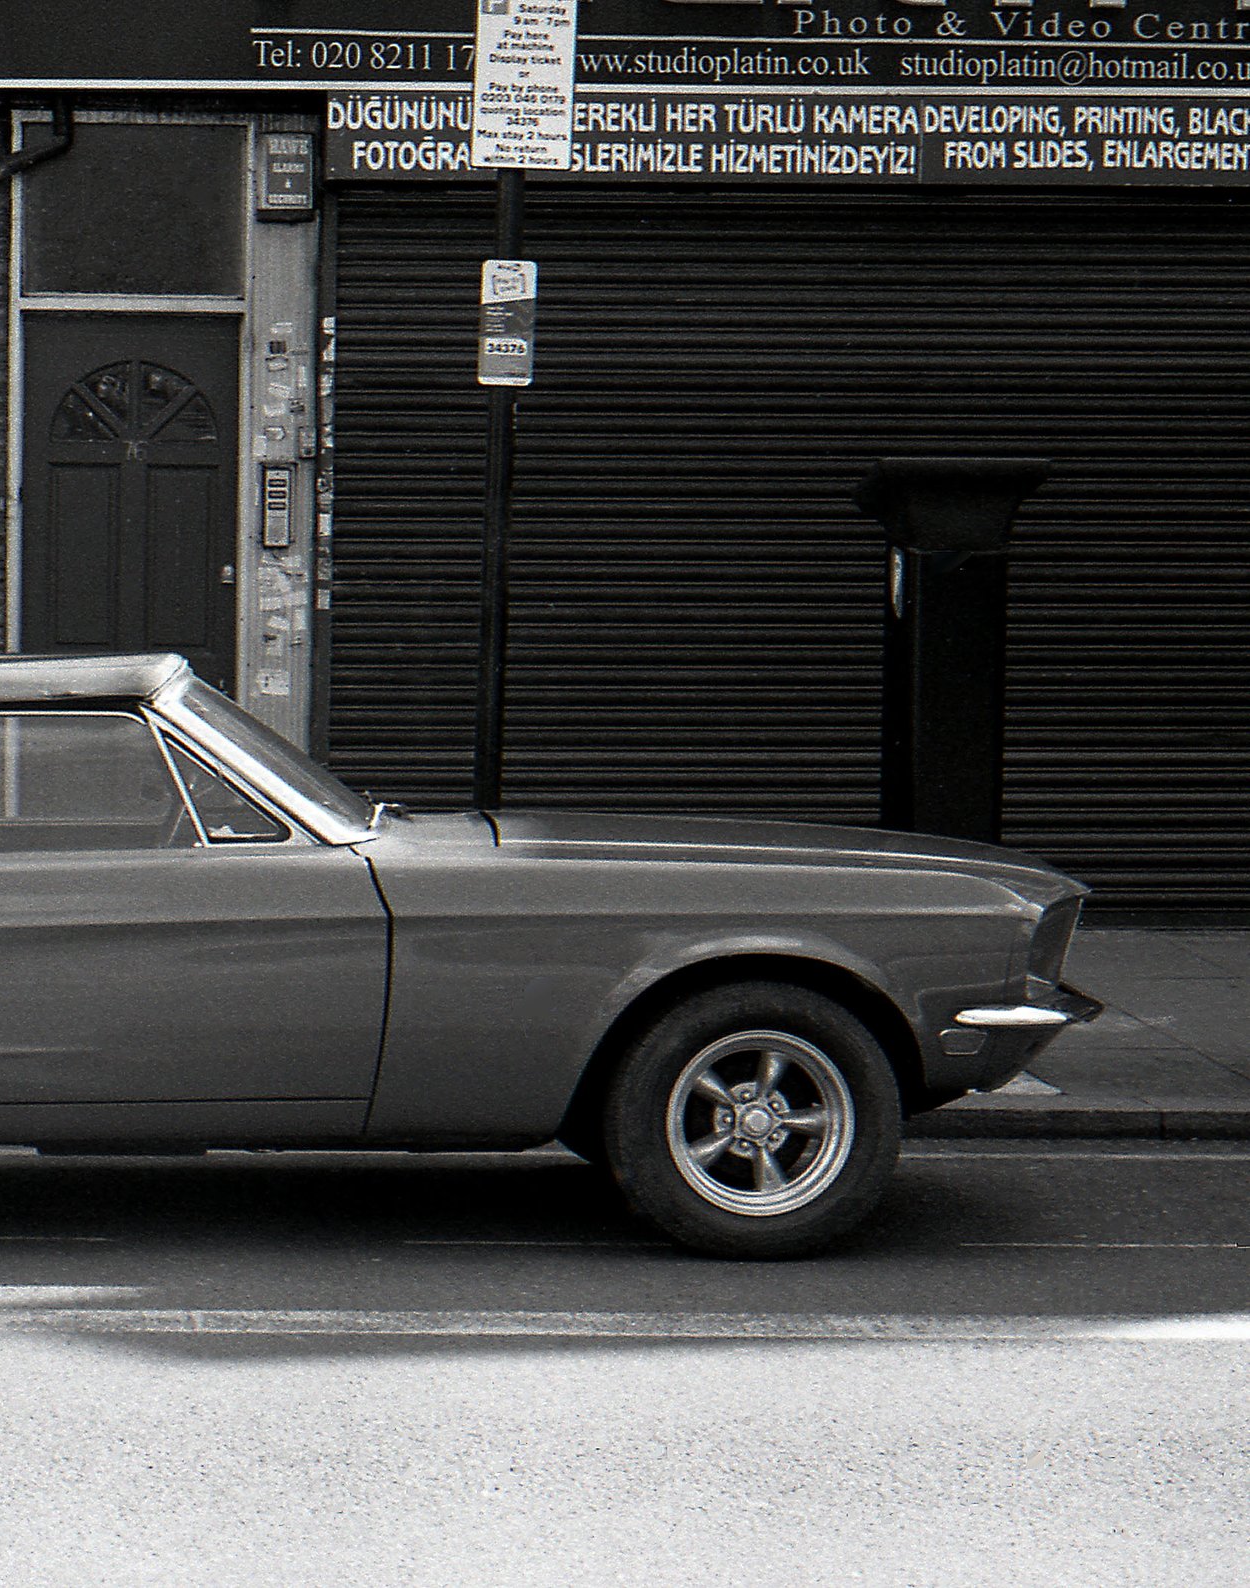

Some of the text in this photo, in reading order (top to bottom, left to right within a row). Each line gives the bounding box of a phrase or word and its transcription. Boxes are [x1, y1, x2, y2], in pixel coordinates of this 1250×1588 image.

[518, 3, 566, 16] Saturday
[792, 9, 911, 35] Photo
[936, 10, 967, 37] &
[991, 11, 1111, 38] Video
[503, 29, 550, 41] Pay here
[496, 41, 555, 52] at machine
[252, 40, 301, 68] Tel:
[312, 41, 362, 69] 020
[369, 42, 432, 71] 8211
[488, 53, 563, 65] Display ticket
[900, 49, 1250, 86] studioplatin@hotmail.co.u
[518, 71, 530, 79] or
[488, 82, 558, 94] Pay by phone
[480, 92, 511, 103] 0203
[480, 106, 567, 117] quoting location
[665, 103, 717, 133] HER
[723, 98, 806, 134] TÜRLÜ
[813, 105, 919, 135] KAMERA
[922, 105, 1066, 137] DEVELOPING,
[1074, 106, 1181, 139] PRINTING,
[477, 129, 569, 141] Max stay 2 hours
[495, 142, 548, 154] No return
[483, 154, 558, 166] within 2 hours
[711, 138, 916, 175] HİZMETİNİZDEYİZ!
[944, 140, 1006, 170] FROM
[1013, 140, 1094, 172] SLIDES,
